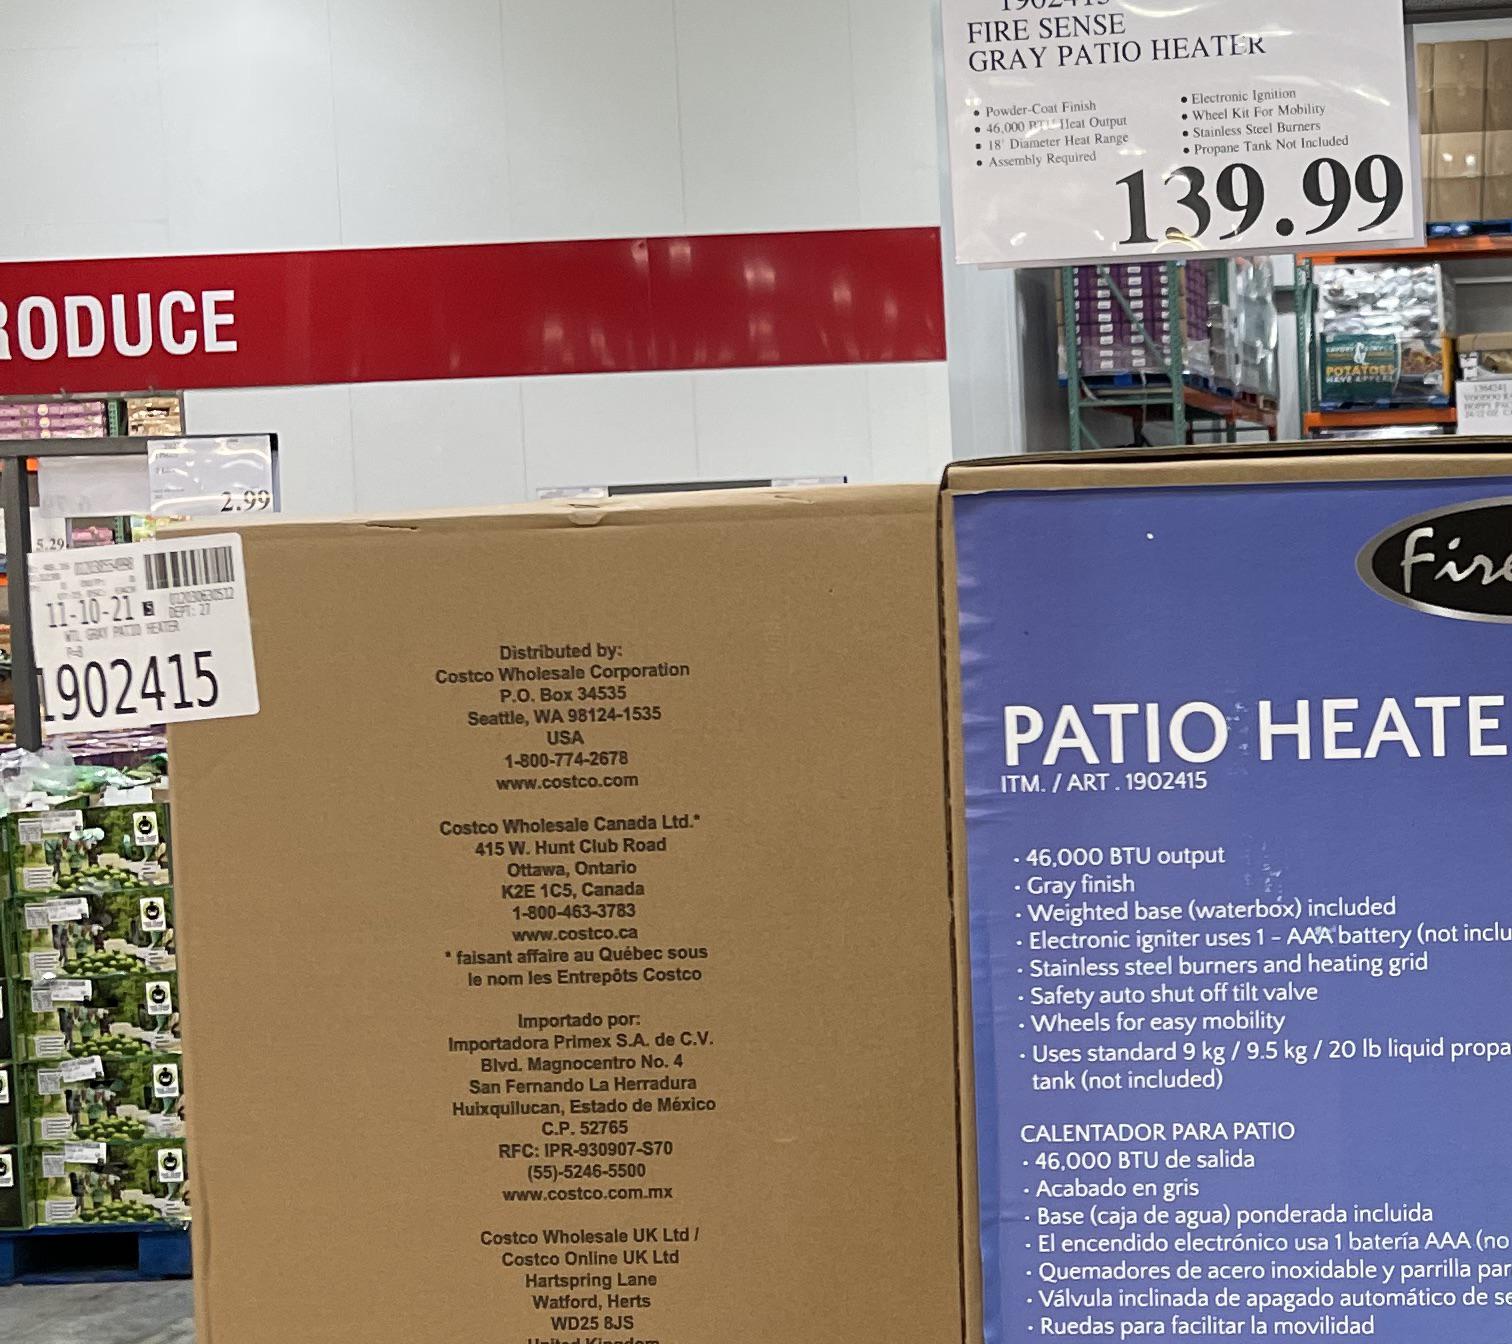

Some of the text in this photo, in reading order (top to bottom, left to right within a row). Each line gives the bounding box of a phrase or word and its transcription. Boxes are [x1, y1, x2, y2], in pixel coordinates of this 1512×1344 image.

[967, 12, 1127, 44] FIRE SENSE
[968, 33, 1266, 73] GRAY PATIO HEATER
[1192, 88, 1297, 105] Electronic Ignition
[986, 99, 1098, 119] Powder-Coat Finish
[1192, 103, 1326, 122] Wheel Kit For Mobility
[1060, 118, 1087, 130] Heat
[1089, 116, 1128, 132] Output
[1193, 120, 1321, 140] Stainless Steel Burners
[1009, 132, 1130, 152] Diameter Heat Range
[1194, 134, 1350, 159] Propane Tank Not Included
[988, 150, 1098, 169] Assembly Required
[1115, 154, 1402, 246] 139.99
[1325, 364, 1395, 377] POTATOES
[220, 489, 272, 513] 2.99
[36, 537, 66, 551] 5.29
[46, 594, 136, 628] 11-10-21
[499, 642, 623, 661] Distributed by:
[435, 662, 691, 685] Costco Wholesale Corporation
[499, 685, 628, 704] P.O. Box 34535
[467, 706, 663, 727] Seattle, WA 98124-1535
[546, 730, 585, 746] USA
[1003, 700, 1228, 768] PATIO
[503, 750, 630, 769] 1-800-774-2678
[495, 774, 640, 791] www.costco.com
[1000, 773, 1046, 794] ITM.
[1051, 773, 1063, 794] /
[1125, 770, 1208, 792] 1902415
[1025, 846, 1226, 870] 46,000 BTU output
[1027, 873, 1136, 900] Gray finish
[1027, 895, 1397, 927] Weighted base (waterbox) included
[1020, 1121, 1296, 1144] CALENTADOR PARA PATIO
